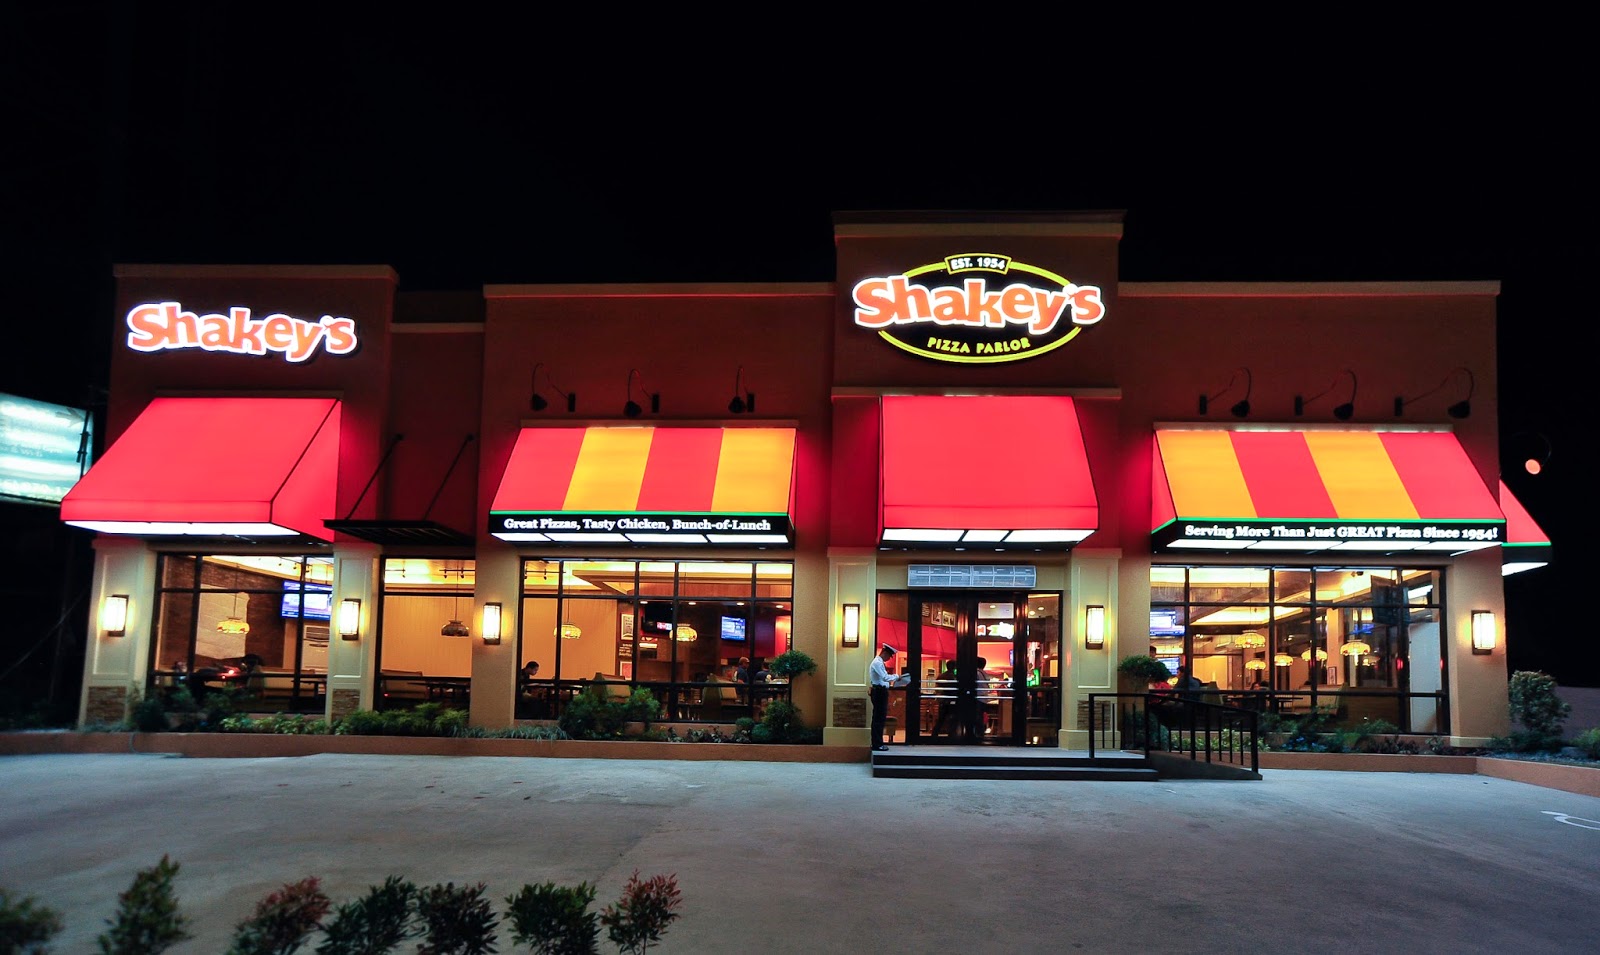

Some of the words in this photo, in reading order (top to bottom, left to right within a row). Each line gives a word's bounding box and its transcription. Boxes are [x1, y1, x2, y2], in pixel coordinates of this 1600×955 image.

[950, 258, 973, 270] EST.
[977, 257, 1005, 270] 1954
[853, 276, 1104, 335] Shakey's
[128, 303, 356, 361] Shakey's
[927, 337, 970, 353] PIZZA
[976, 337, 1031, 354] PARLOR
[503, 518, 538, 529] Great
[540, 518, 581, 531] Pizzas,
[583, 518, 616, 531] Tasty
[617, 518, 670, 531] Chicken,
[672, 518, 771, 530] Bunch-of-Lunch
[1185, 524, 1234, 539] Serving
[1235, 526, 1270, 537] More
[1271, 526, 1305, 537] Than
[1306, 526, 1336, 537] Just
[1336, 526, 1385, 538] GREAT
[1386, 526, 1421, 538] Pizza
[1422, 526, 1460, 538] Since
[1461, 527, 1498, 540] 1954!
